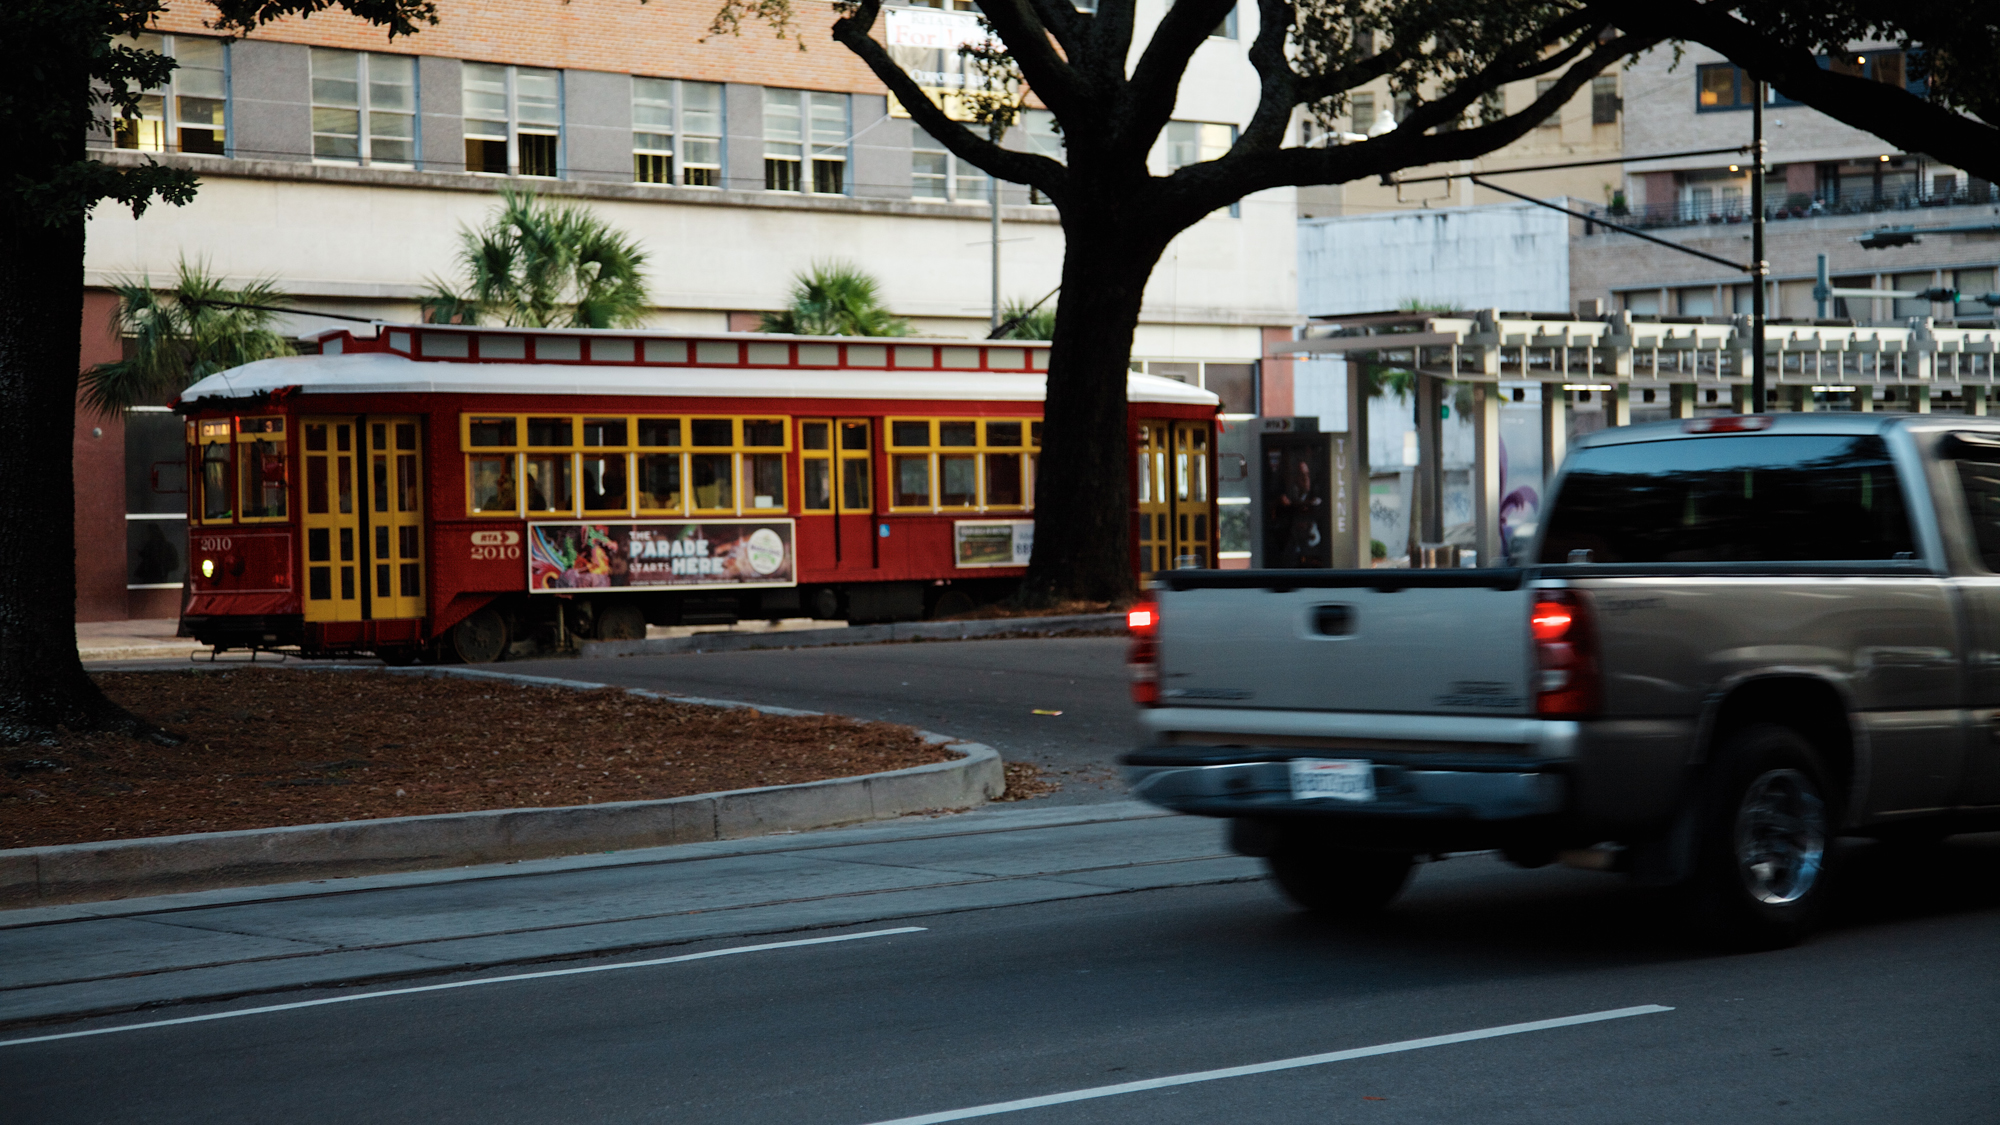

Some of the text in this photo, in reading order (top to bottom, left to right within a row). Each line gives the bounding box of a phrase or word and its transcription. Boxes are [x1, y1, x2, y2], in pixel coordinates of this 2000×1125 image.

[895, 24, 937, 45] For
[1337, 438, 1347, 533] TULANE
[201, 538, 231, 551] 2010
[628, 531, 652, 541] THE
[471, 546, 520, 559] 2010
[629, 540, 709, 558] PARADE
[629, 556, 724, 575] STARTS HERE
